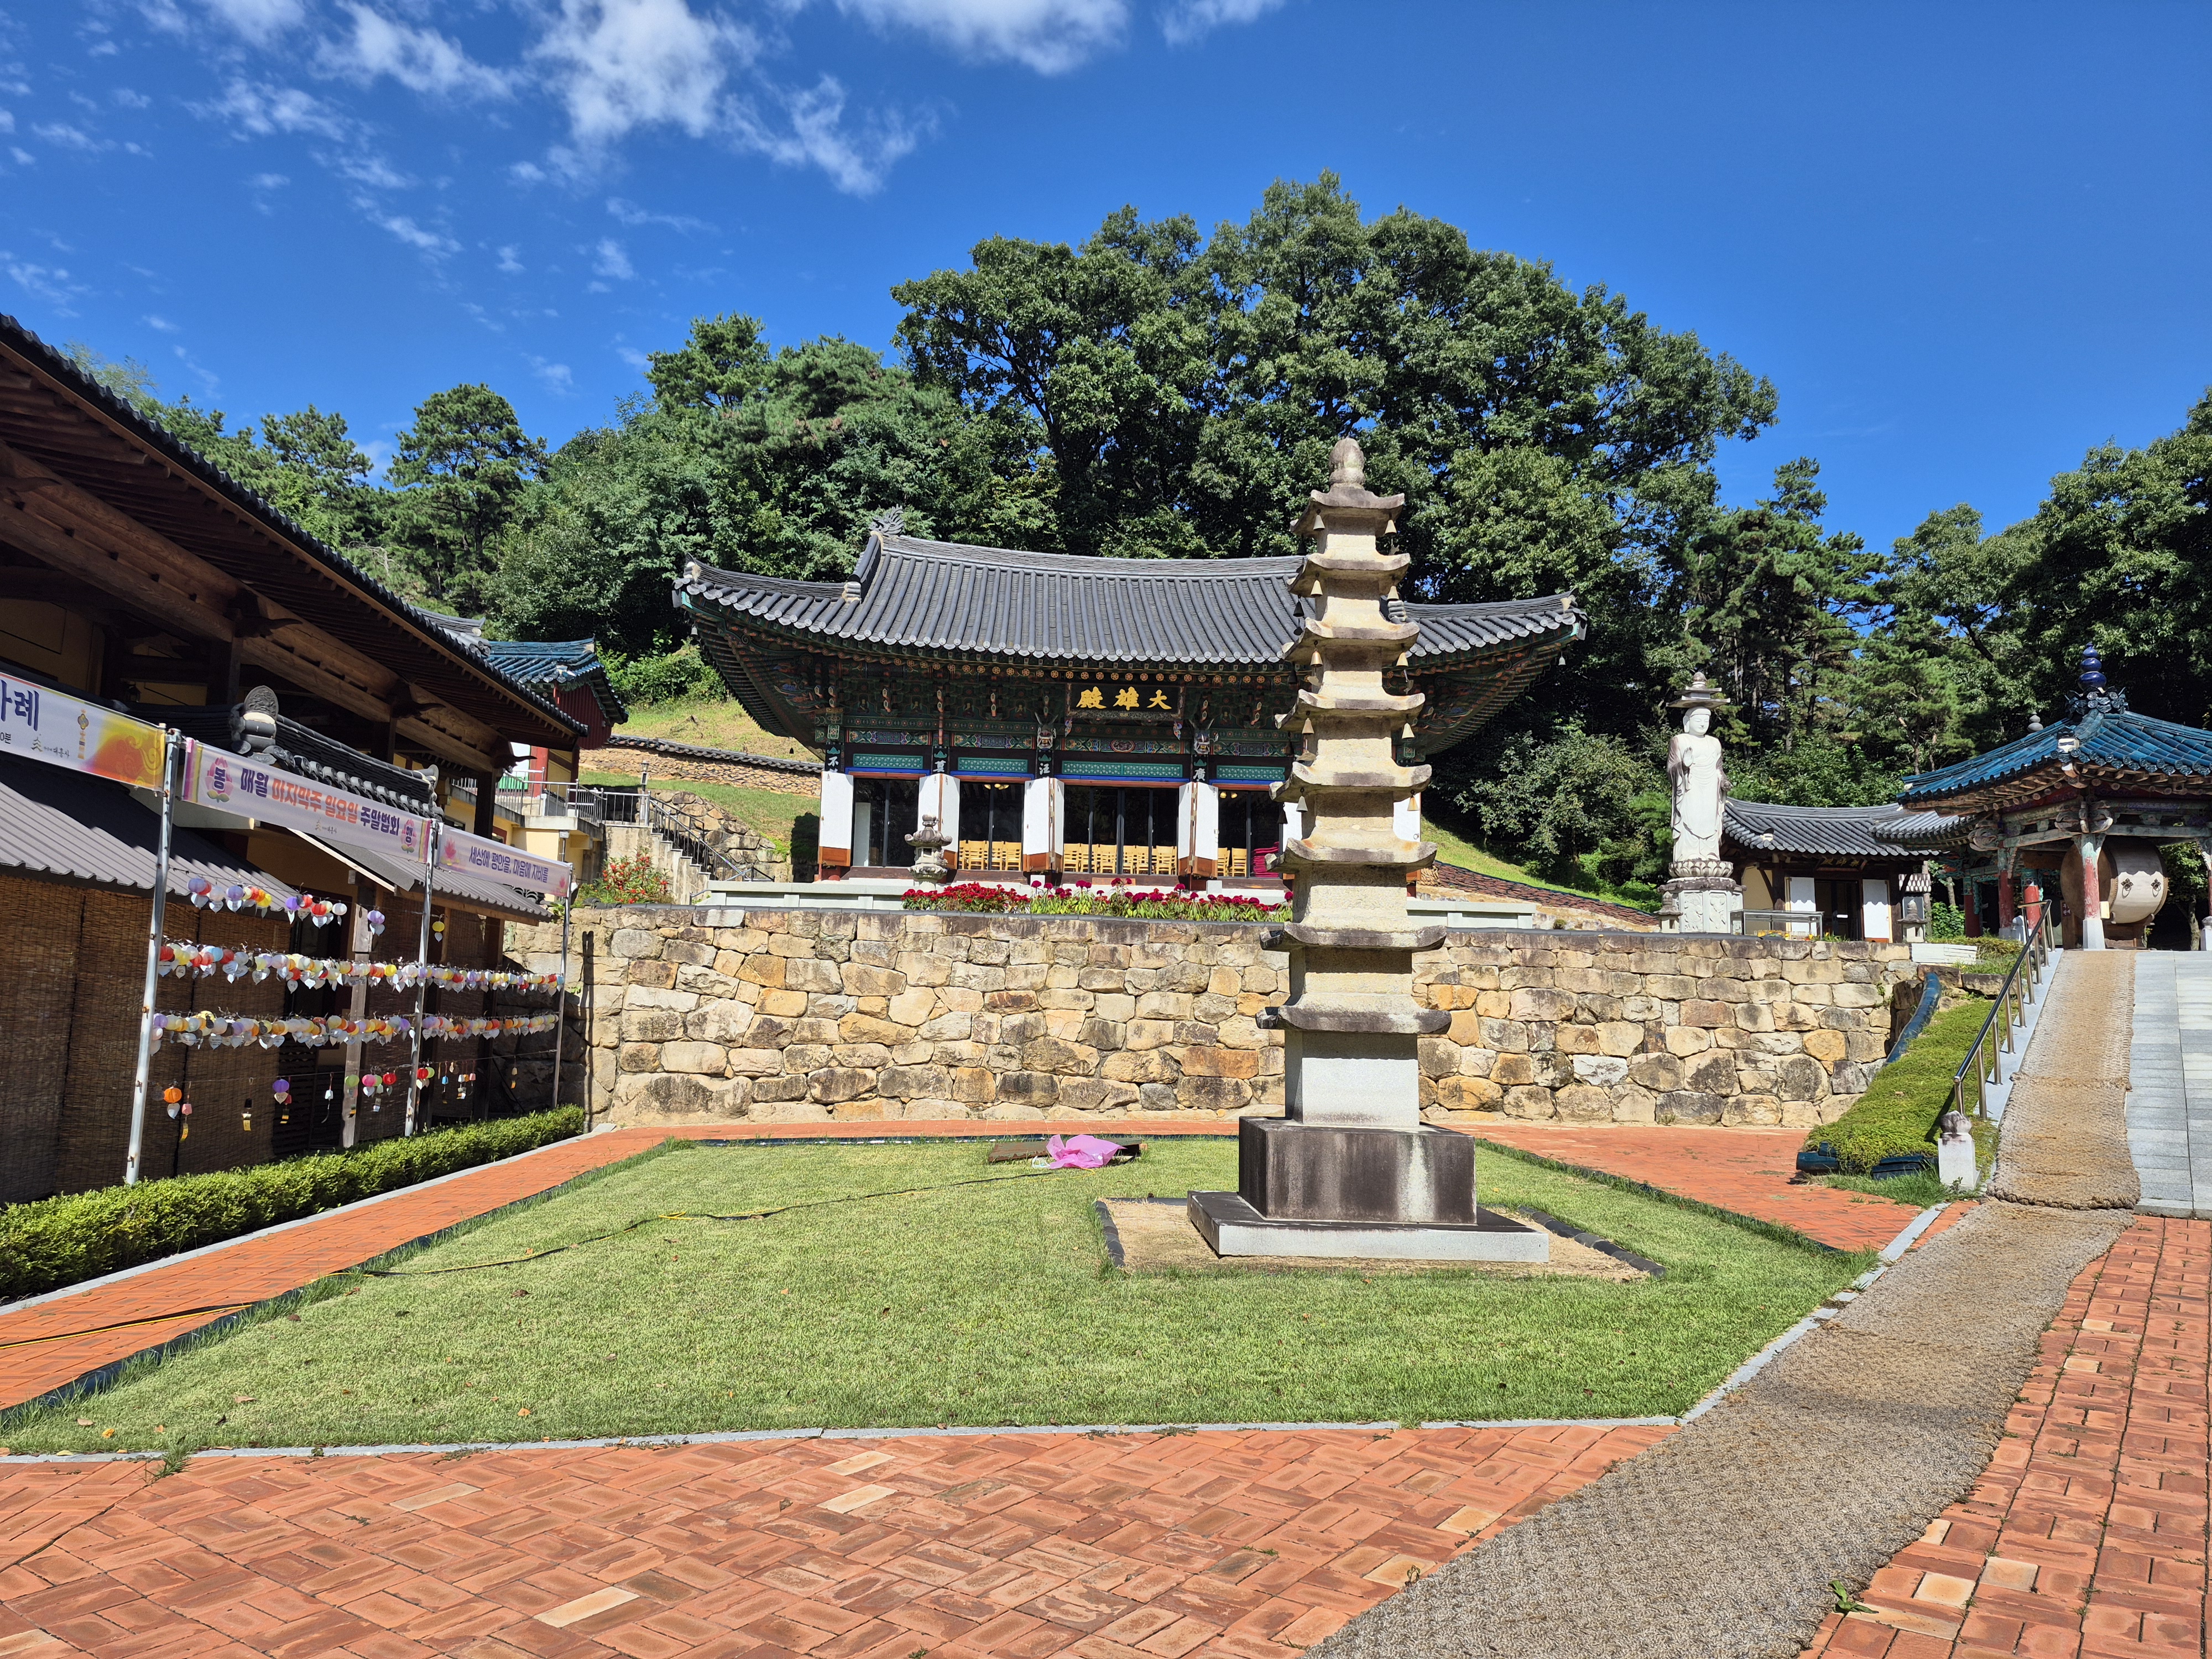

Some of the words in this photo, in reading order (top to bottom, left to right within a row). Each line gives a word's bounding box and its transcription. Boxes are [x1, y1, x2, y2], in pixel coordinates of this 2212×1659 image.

[53, 747, 70, 759] 대흥사
[214, 767, 226, 789] 봉
[241, 768, 269, 797] 매월
[272, 778, 322, 812] 마지막주
[325, 795, 358, 823] 일요일
[361, 806, 400, 836] 주말법회
[469, 846, 491, 868] 세상에
[492, 852, 512, 874] 평안을,
[513, 859, 531, 878] 마음에
[531, 864, 549, 883] 자비를
